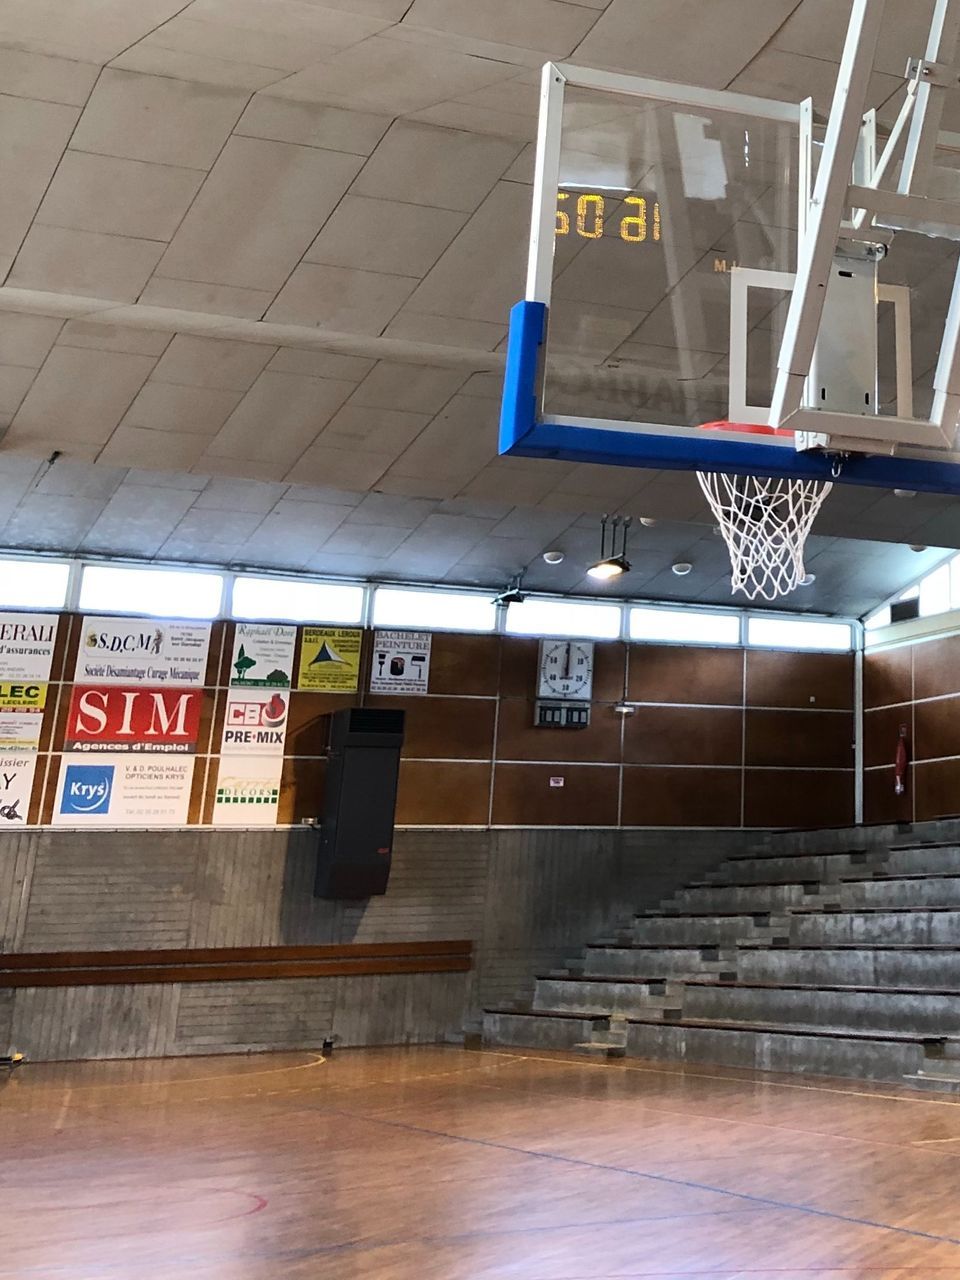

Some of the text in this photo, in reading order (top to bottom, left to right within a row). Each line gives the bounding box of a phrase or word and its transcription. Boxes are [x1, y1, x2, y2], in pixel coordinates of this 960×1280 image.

[376, 640, 429, 650] PEINTURE
[76, 690, 194, 735] SIM
[73, 742, 188, 752] Agences d'Emploi
[70, 782, 104, 800] Krys
